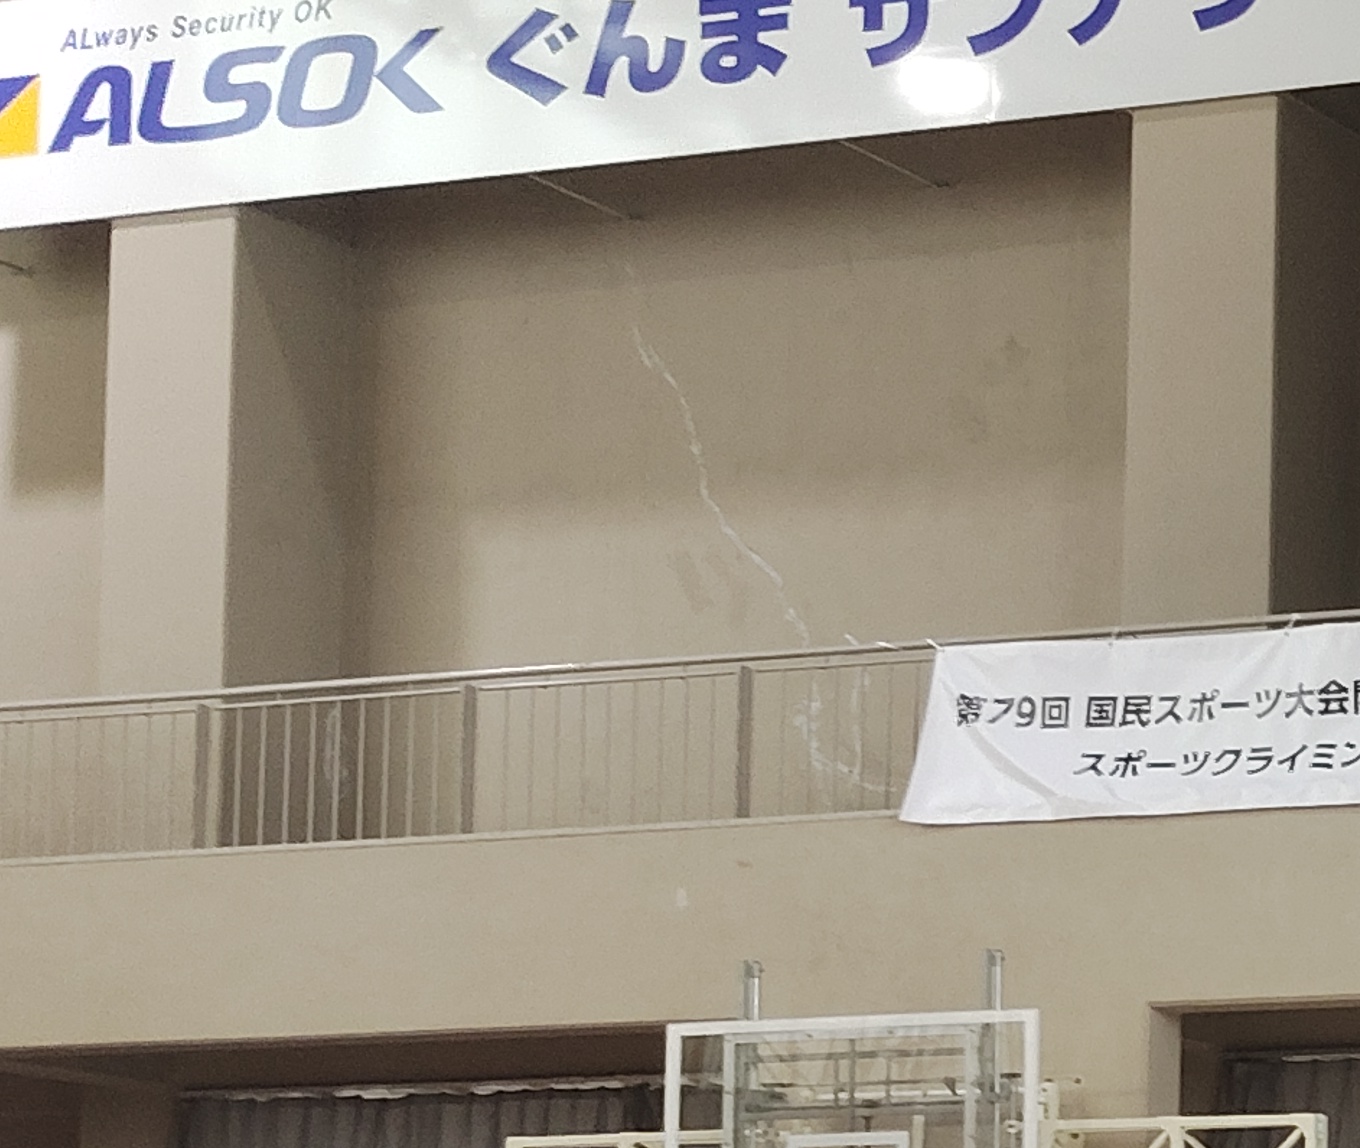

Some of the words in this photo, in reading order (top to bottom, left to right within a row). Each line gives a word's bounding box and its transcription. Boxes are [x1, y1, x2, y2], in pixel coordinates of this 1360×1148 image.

[60, 22, 159, 53] ALways
[170, 7, 284, 39] Security
[294, 0, 333, 24] OK
[486, 0, 791, 107] ぐんま
[47, 26, 444, 153] ALSOK
[957, 692, 1071, 729] 第79回
